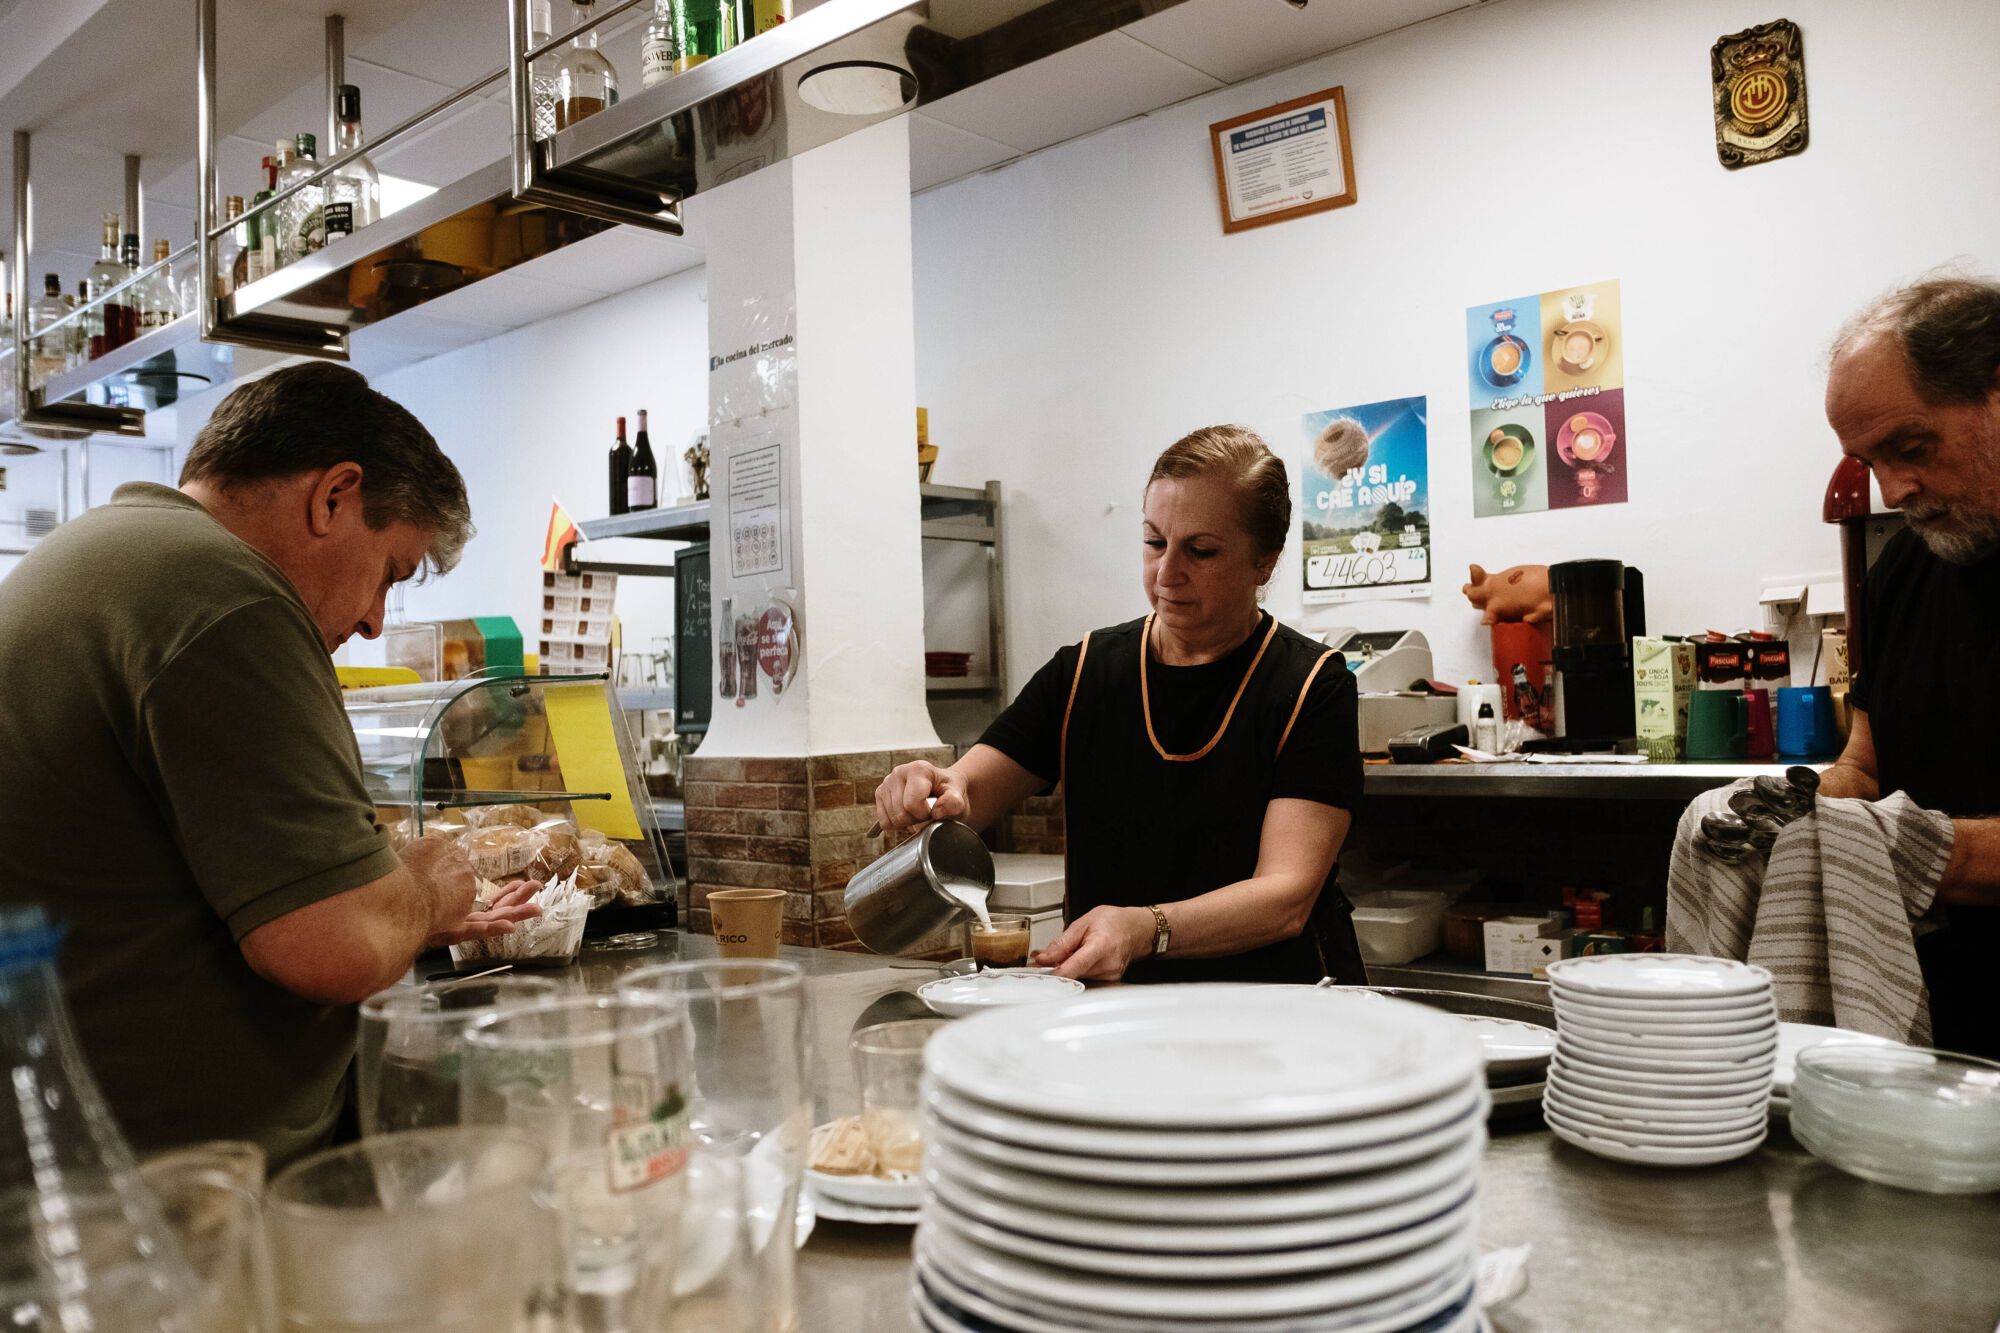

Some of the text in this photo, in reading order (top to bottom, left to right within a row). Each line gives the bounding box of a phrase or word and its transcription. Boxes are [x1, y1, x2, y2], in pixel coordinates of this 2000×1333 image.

[725, 349, 747, 364] cocina
[748, 343, 760, 356] del
[761, 334, 794, 352] mercado
[1520, 393, 1533, 406] la
[1534, 393, 1556, 406] que
[1558, 386, 1602, 403] quieres
[1368, 463, 1388, 485] SI
[1316, 487, 1354, 511] CAE
[1322, 551, 1397, 585] 44603
[761, 634, 771, 645] se
[1710, 655, 1738, 666] Pascual
[1760, 652, 1787, 665] Pascual
